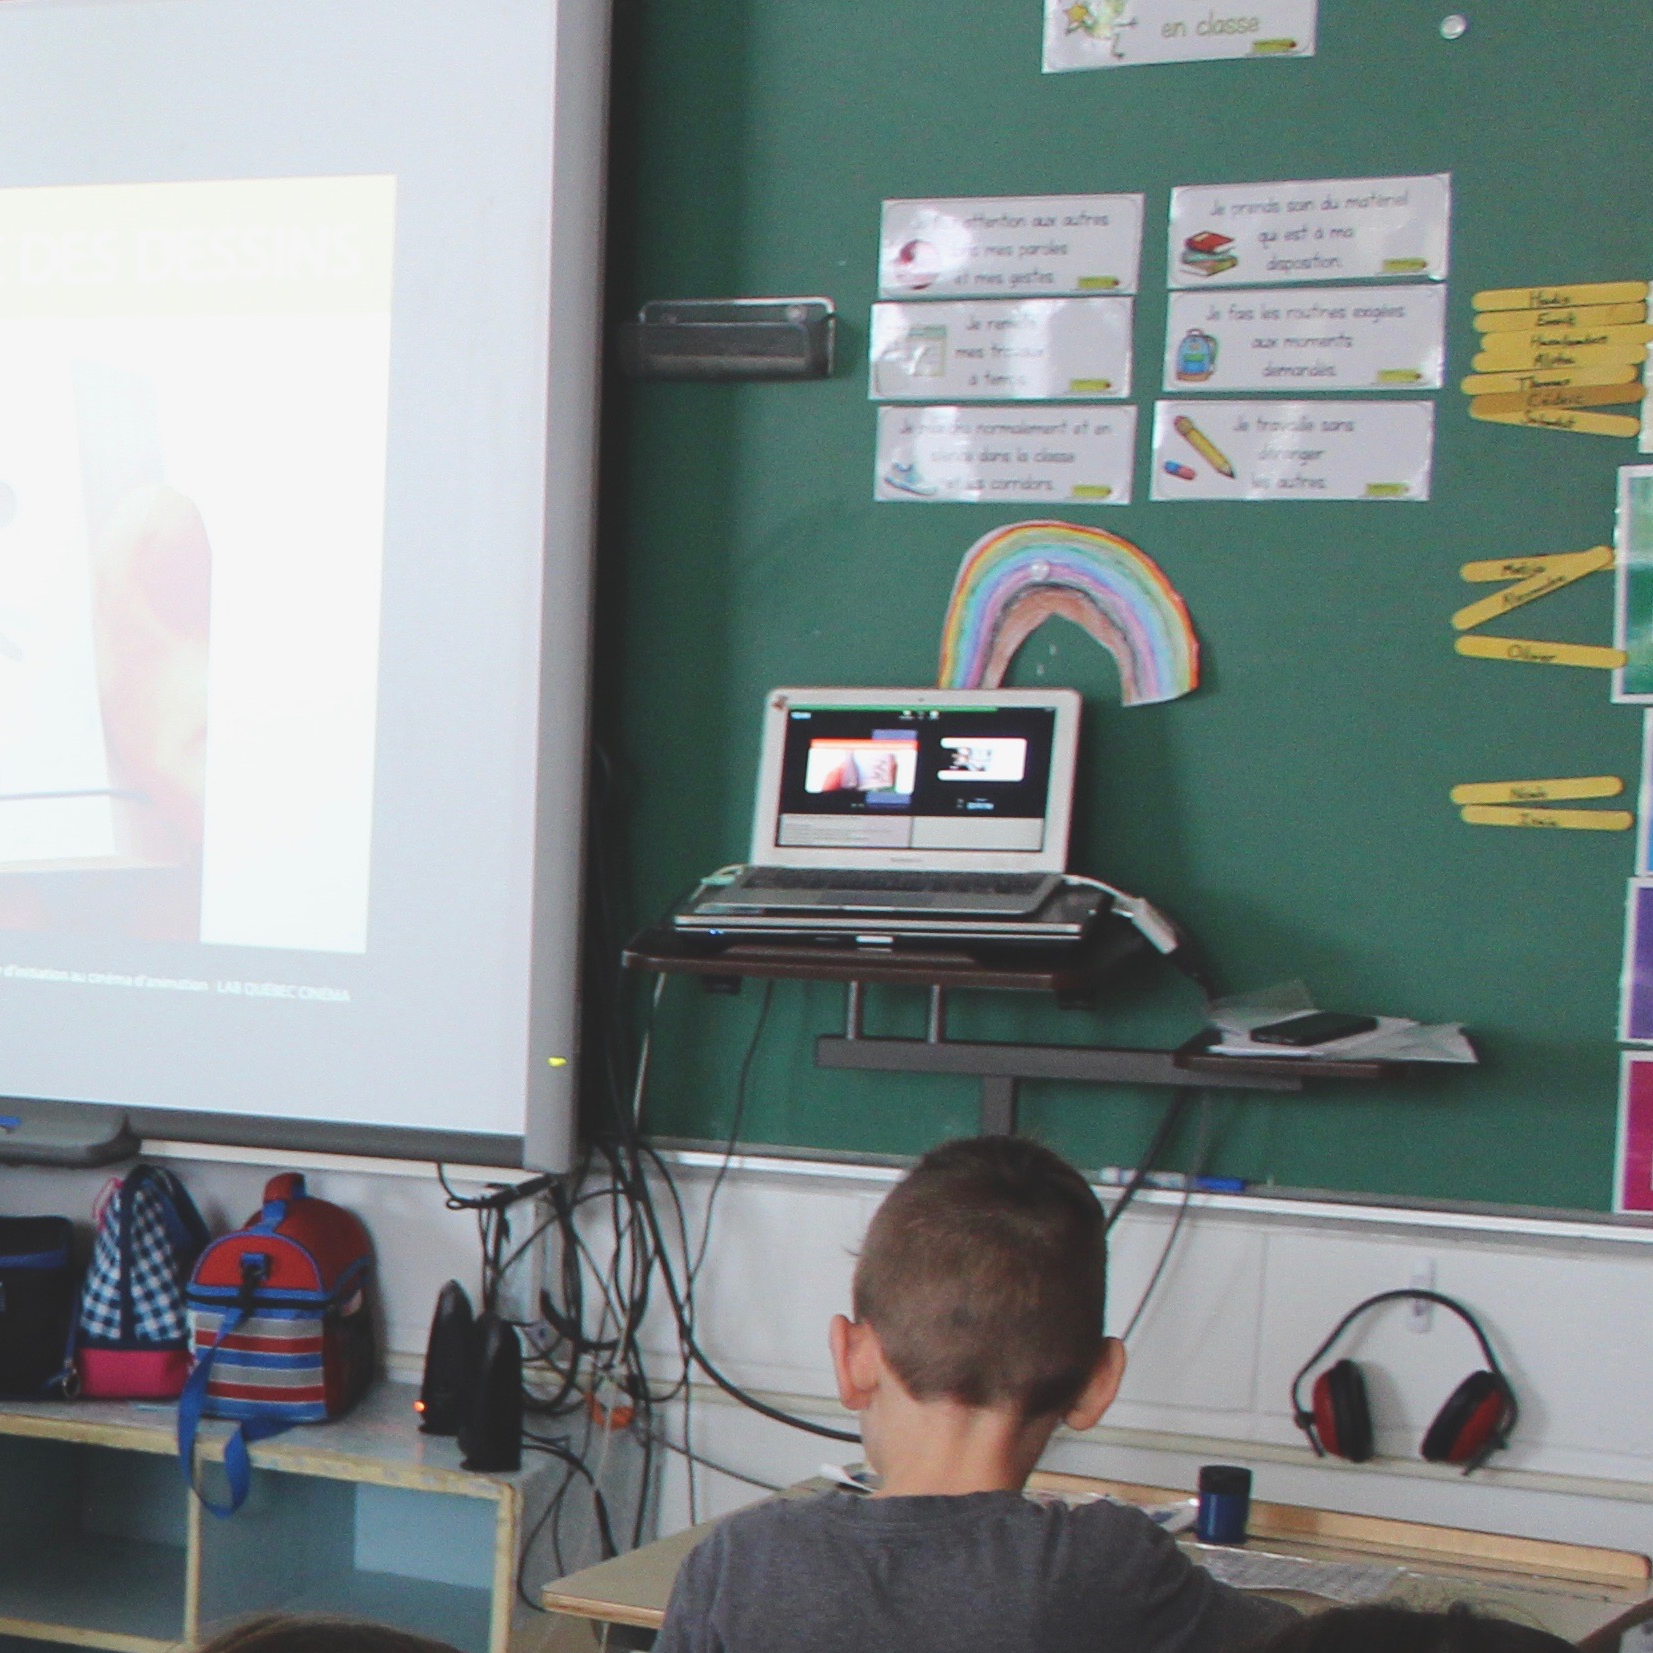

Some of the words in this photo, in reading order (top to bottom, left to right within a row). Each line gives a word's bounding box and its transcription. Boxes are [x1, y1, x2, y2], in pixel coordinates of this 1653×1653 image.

[1160, 20, 1186, 38] en
[1196, 10, 1260, 37] classe
[1320, 196, 1340, 212] du
[1062, 212, 1110, 228] autres
[20, 231, 120, 287] DES
[136, 223, 361, 284] DESSINS
[1018, 241, 1068, 263] paroles
[1010, 269, 1055, 290] gestes
[1283, 333, 1353, 349] moments
[976, 416, 1068, 437] normalement
[1034, 449, 1076, 463] classe
